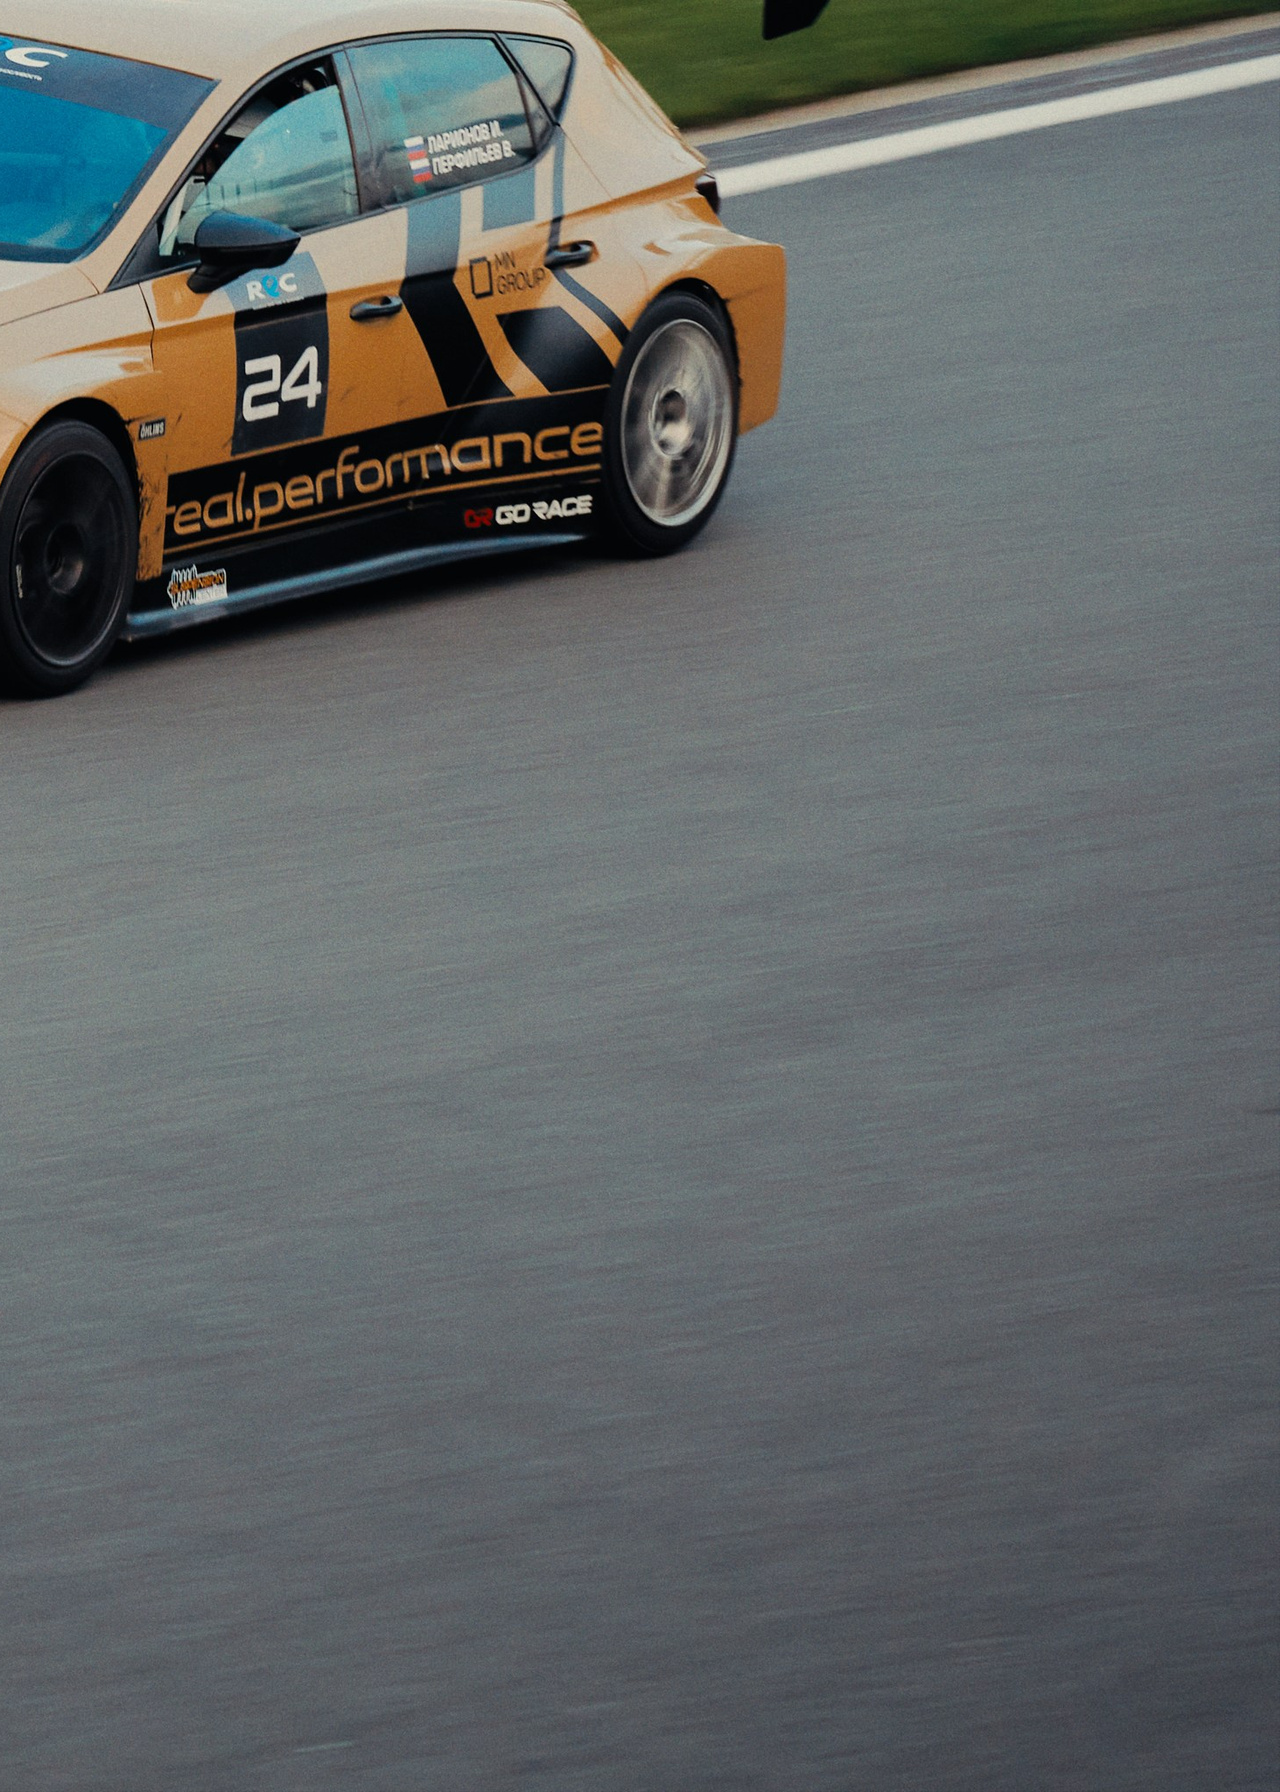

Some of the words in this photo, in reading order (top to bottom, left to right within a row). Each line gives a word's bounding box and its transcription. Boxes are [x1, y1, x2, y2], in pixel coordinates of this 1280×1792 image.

[427, 123, 491, 154] ЛАРИОНОВ
[431, 142, 503, 175] ПЕРФИЛЬЕВ
[501, 140, 516, 158] В.
[494, 250, 516, 272] MN
[497, 267, 546, 295] GROUP
[243, 345, 322, 422] 24
[165, 421, 604, 536] eal.performance
[495, 503, 531, 525] GO
[532, 494, 593, 520] RACE
